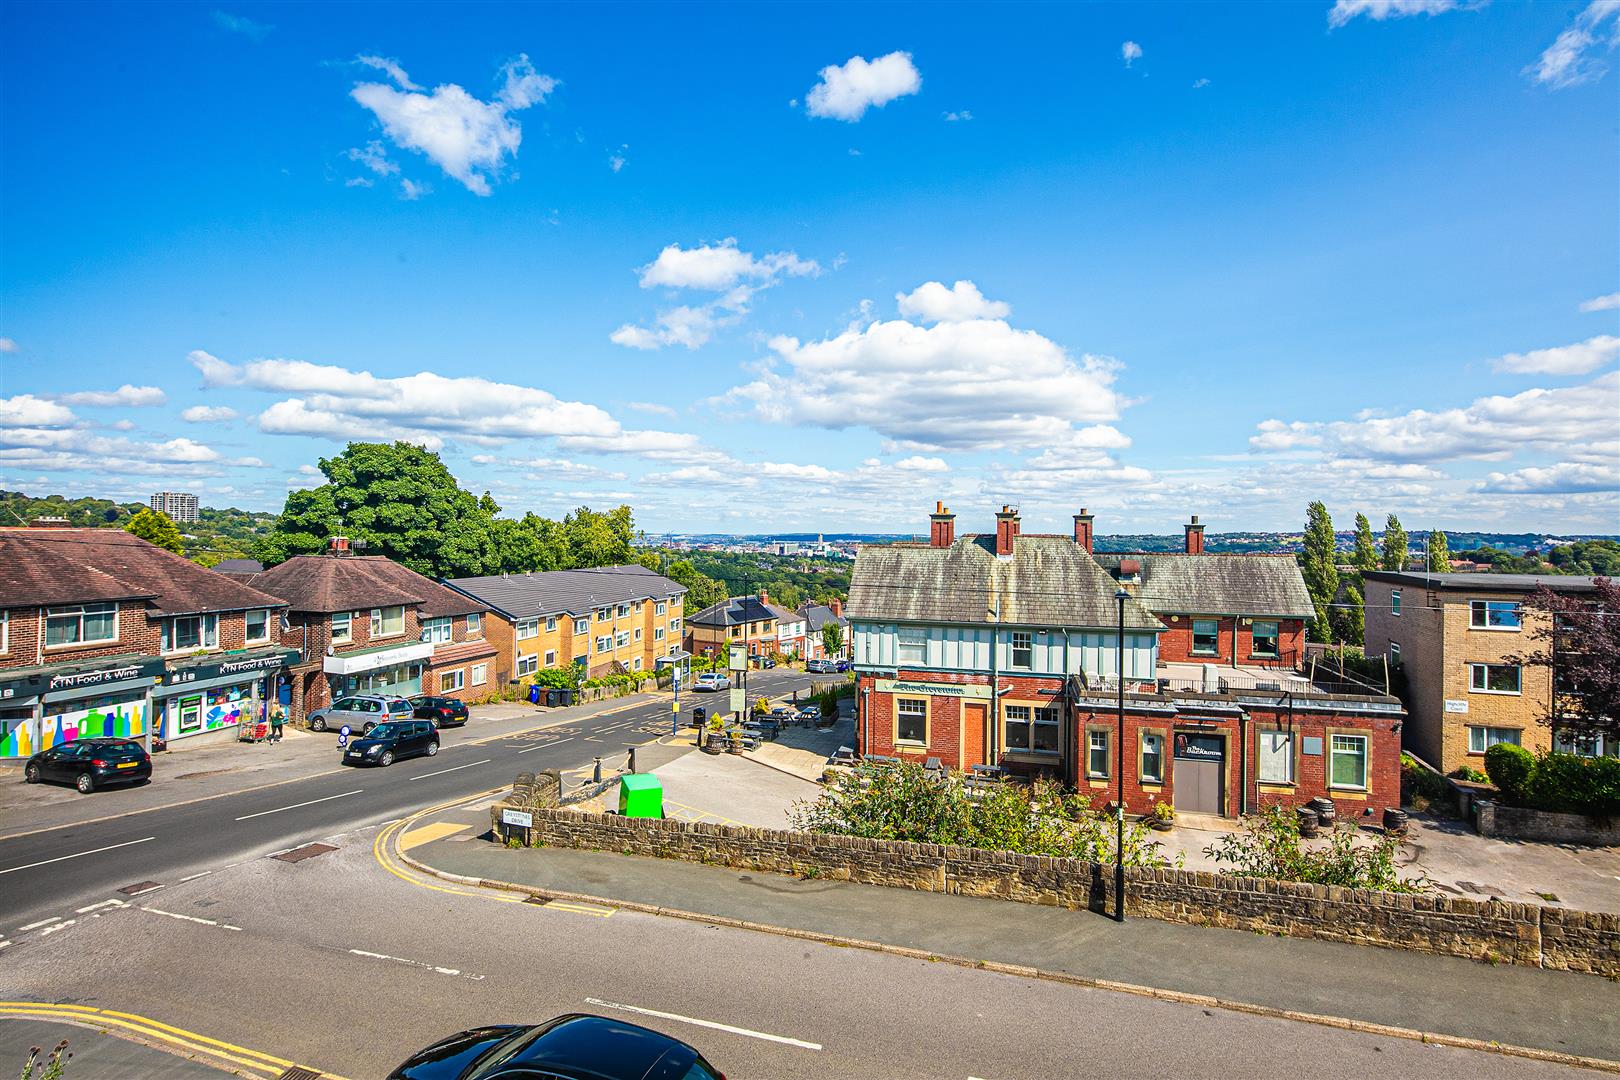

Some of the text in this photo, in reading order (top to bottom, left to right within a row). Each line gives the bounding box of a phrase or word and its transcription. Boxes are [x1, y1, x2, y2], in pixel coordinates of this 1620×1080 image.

[219, 664, 237, 674] KTN
[238, 661, 257, 671] Food
[264, 659, 282, 667] Wine
[50, 668, 138, 689] KTN Food & Wine
